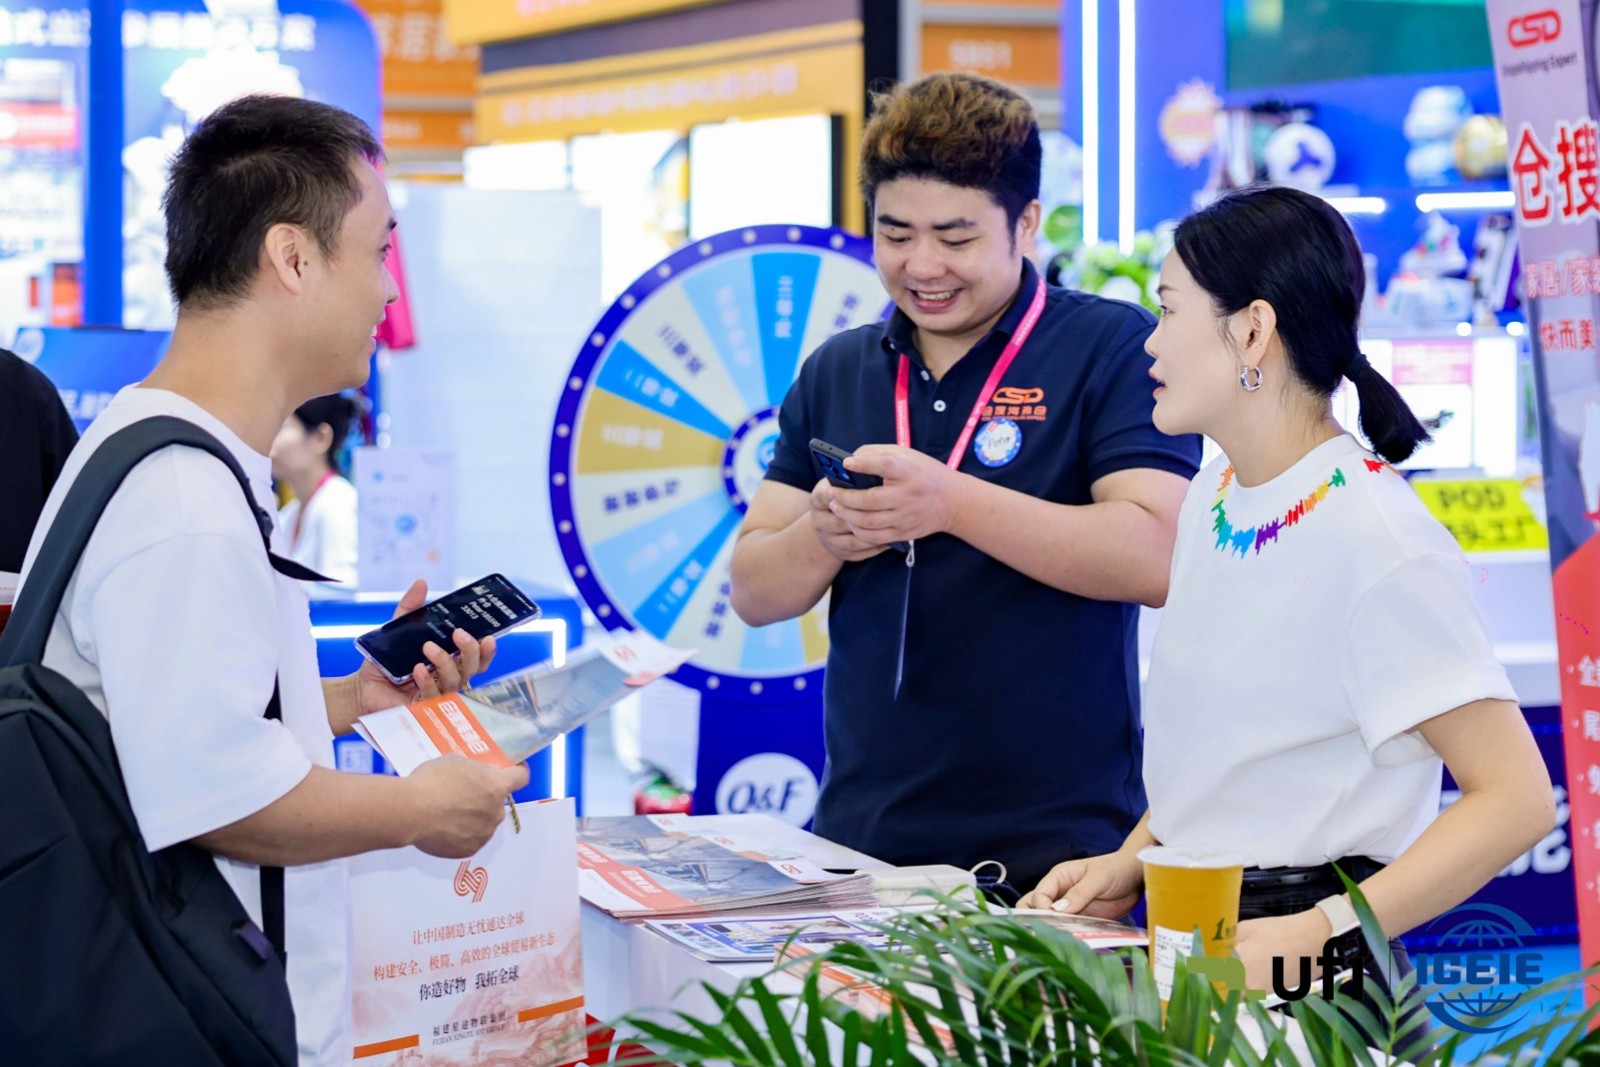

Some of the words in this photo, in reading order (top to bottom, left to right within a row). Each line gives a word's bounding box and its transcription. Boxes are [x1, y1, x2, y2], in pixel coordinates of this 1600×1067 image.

[1506, 9, 1562, 48] CSD
[1513, 123, 1600, 221] 仓搜
[1438, 485, 1505, 510] POD
[727, 777, 806, 814] Q&F
[412, 911, 525, 945] 让中国制造无忧通达全球
[420, 976, 466, 1001] 你造好物
[475, 965, 520, 990] 我拓全球
